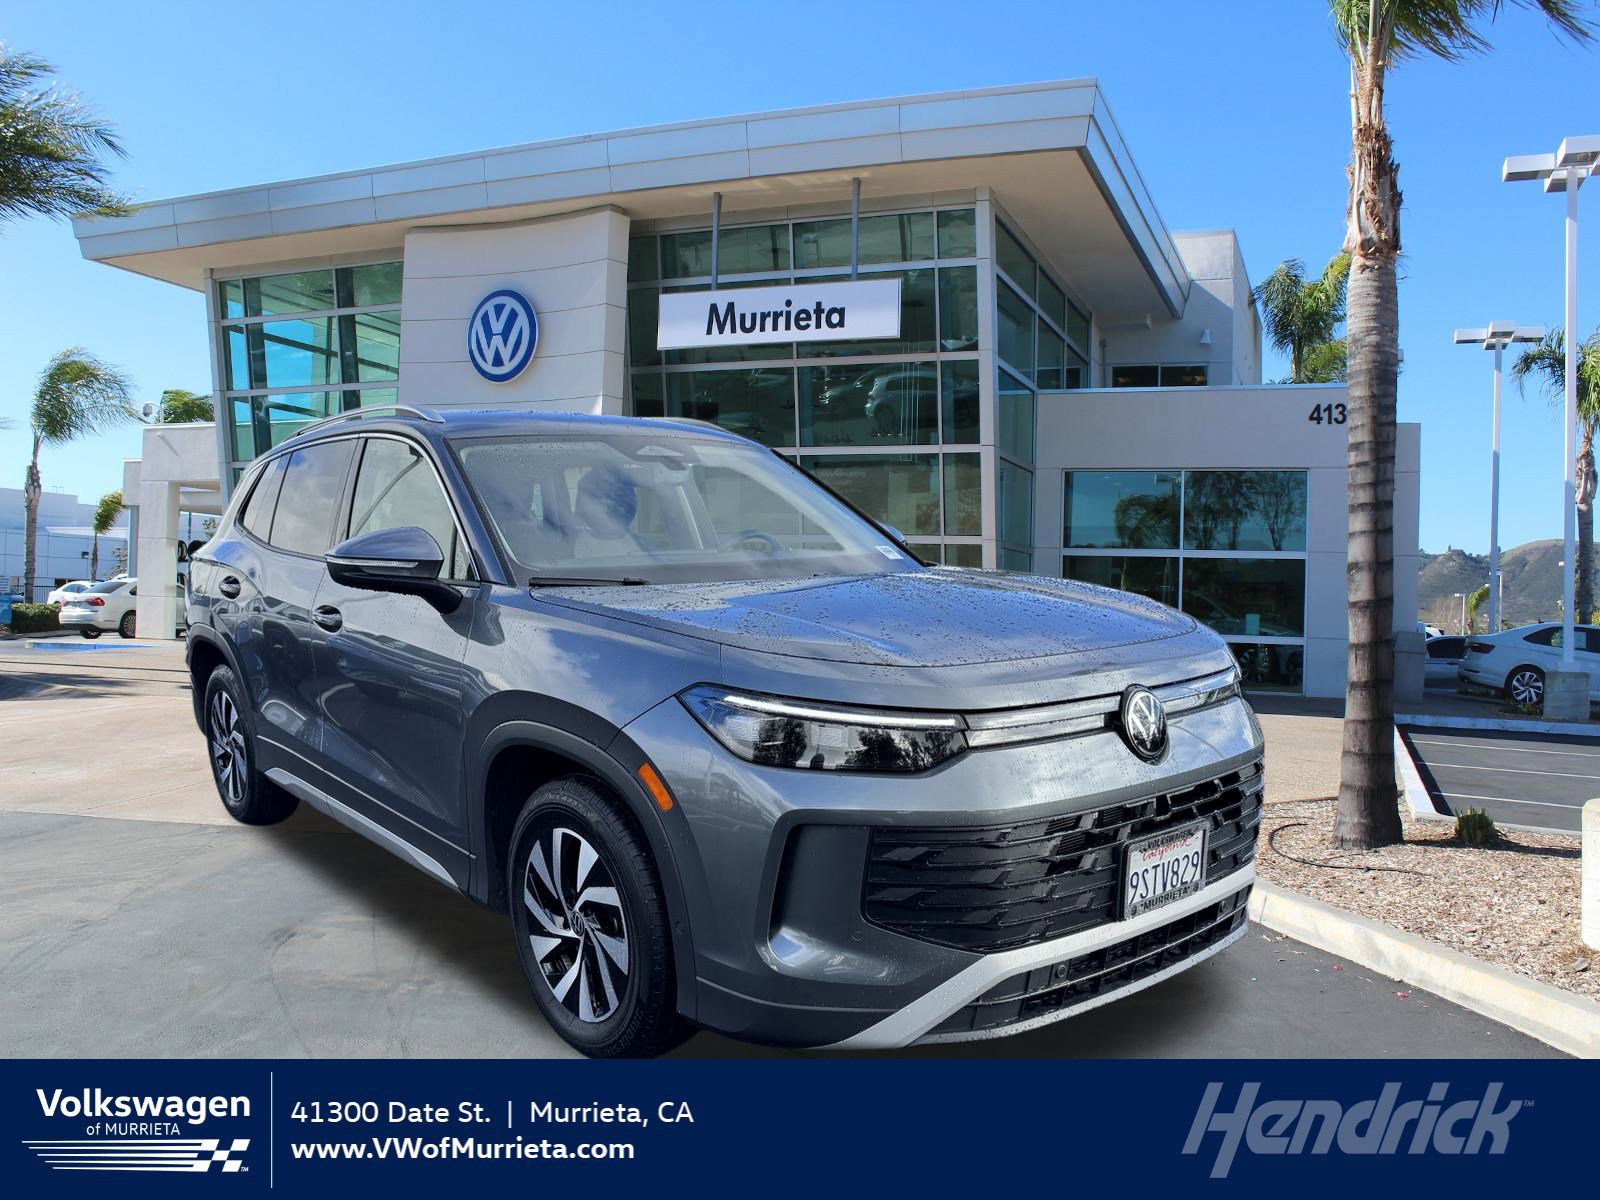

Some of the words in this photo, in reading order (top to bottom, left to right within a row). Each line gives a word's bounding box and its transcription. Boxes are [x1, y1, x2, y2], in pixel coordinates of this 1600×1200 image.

[706, 299, 846, 336] Murrieta
[1308, 403, 1347, 425] 413
[1147, 828, 1195, 851] VOLKSWAGEN
[1129, 850, 1201, 905] 9STV829
[1143, 887, 1189, 911] MURRIETA
